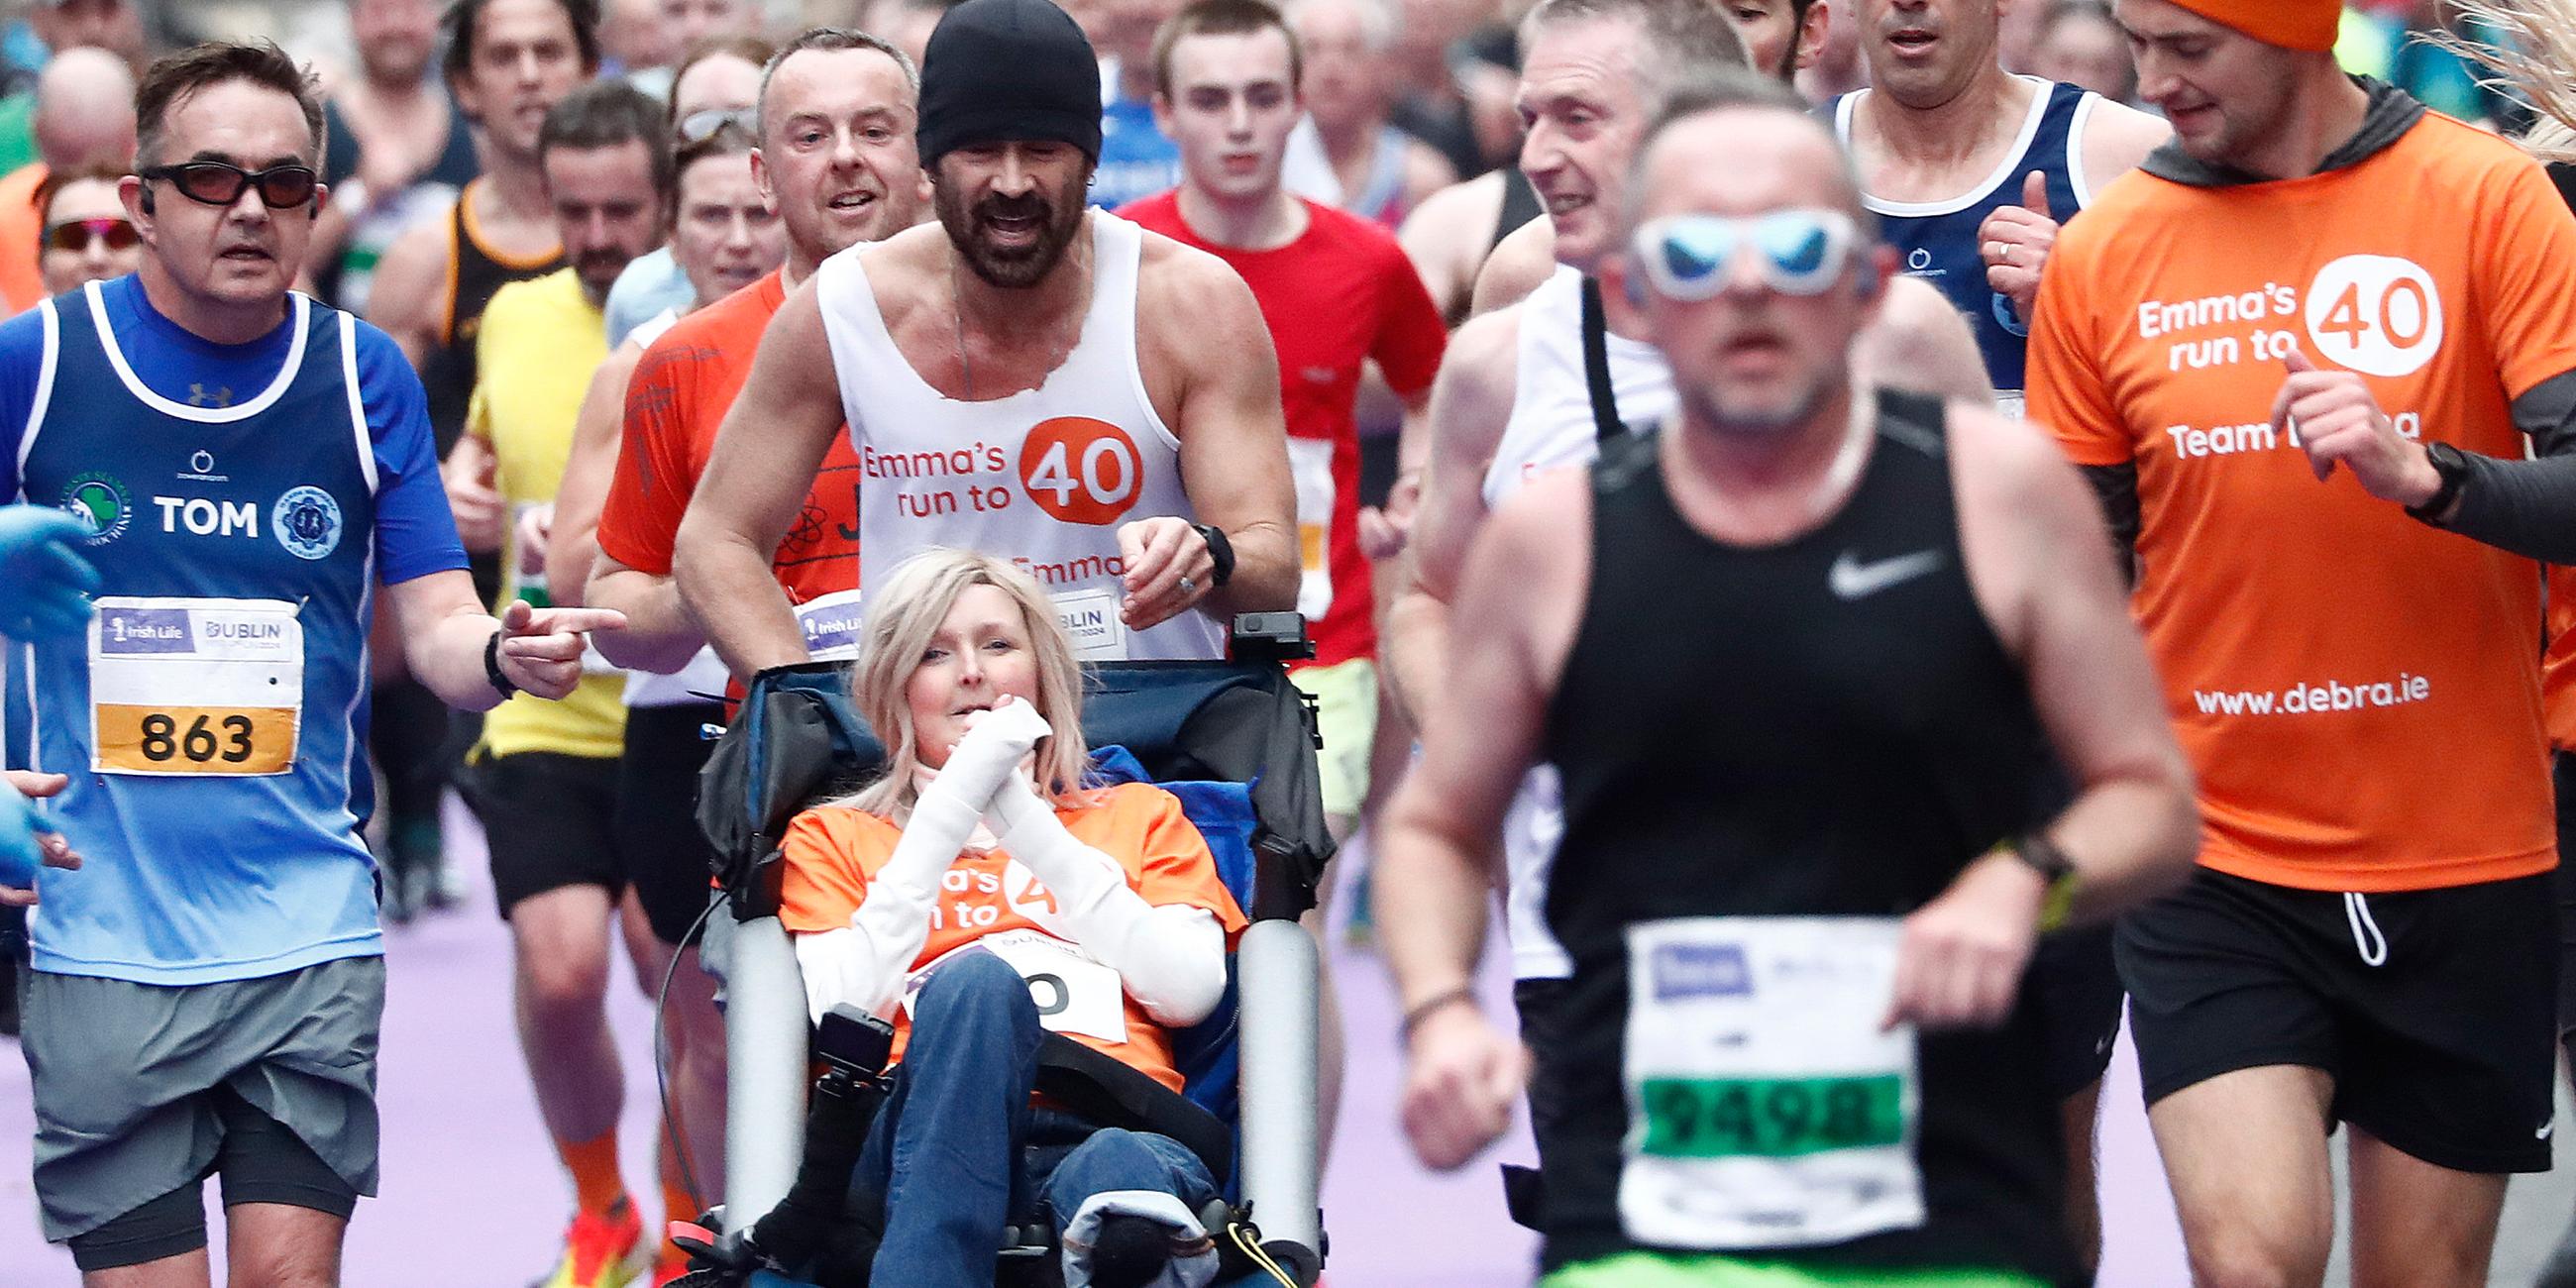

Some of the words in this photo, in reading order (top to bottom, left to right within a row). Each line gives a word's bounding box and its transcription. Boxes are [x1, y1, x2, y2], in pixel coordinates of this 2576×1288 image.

[2138, 281, 2297, 338] Emma's
[2317, 276, 2428, 350] 40
[2169, 336, 2239, 372] run
[2250, 329, 2298, 362] to
[2167, 423, 2276, 460] Team
[864, 441, 1008, 478] Emma's
[1026, 437, 1135, 507] 40
[154, 495, 258, 538] TOM
[899, 489, 957, 517] run
[968, 484, 1012, 511] to
[127, 625, 157, 639] Irish
[158, 625, 183, 639] Life
[206, 621, 281, 639] DUBLIN
[818, 618, 846, 634] Irish
[1060, 609, 1103, 628] BLIN
[2195, 673, 2429, 715] www.debra.ie
[142, 713, 254, 762] 863
[1016, 874, 1057, 914] 4
[954, 901, 999, 928] to
